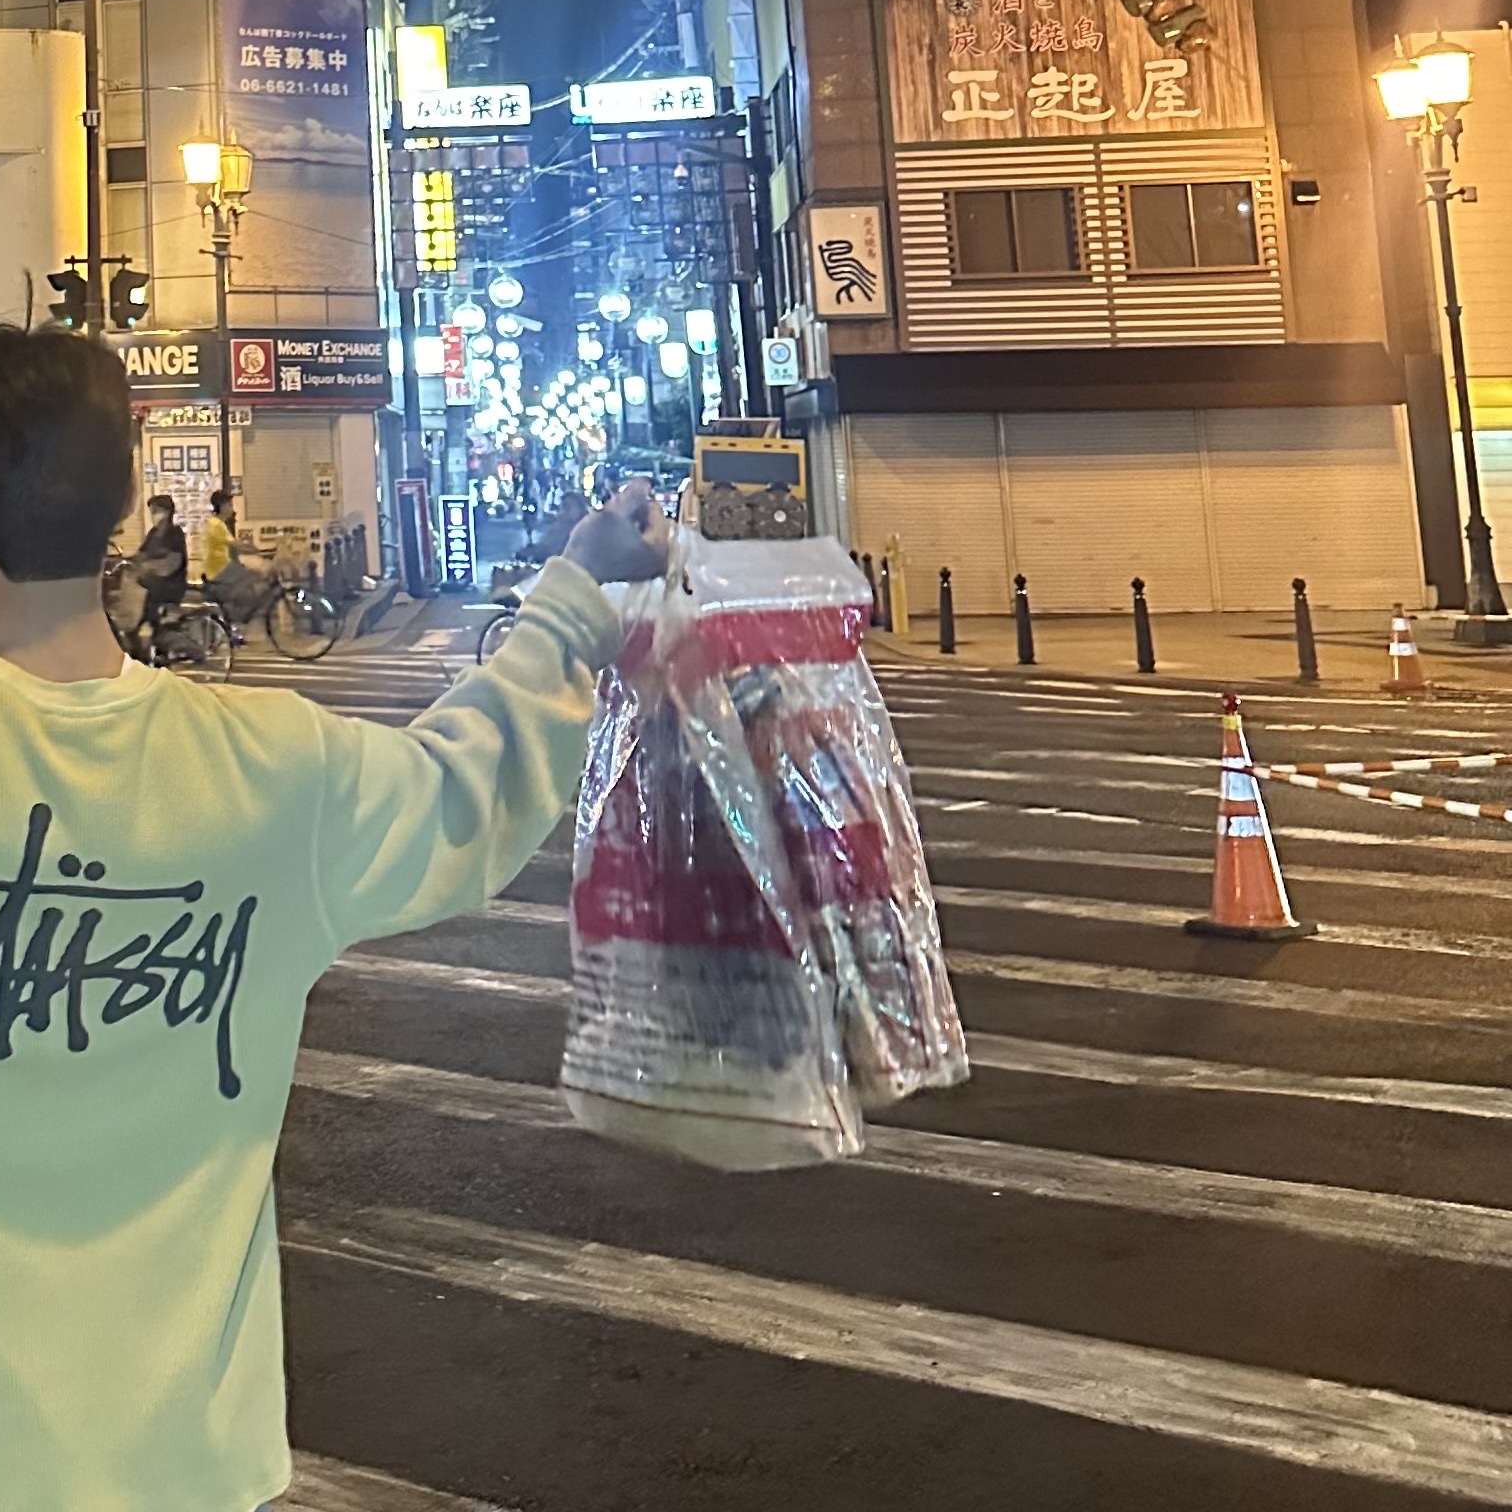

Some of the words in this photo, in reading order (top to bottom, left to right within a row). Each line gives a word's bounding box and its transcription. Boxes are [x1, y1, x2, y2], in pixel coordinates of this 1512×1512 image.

[948, 17, 1105, 58] 炭火焼鳥
[240, 44, 348, 72] 広告募集中
[240, 78, 349, 97] 06-6621-1481
[941, 58, 1202, 123] 正起屋
[277, 339, 319, 356] MONEY
[321, 339, 383, 356] EXCHANGE
[280, 365, 302, 391] 酒
[303, 373, 335, 387] Liquor
